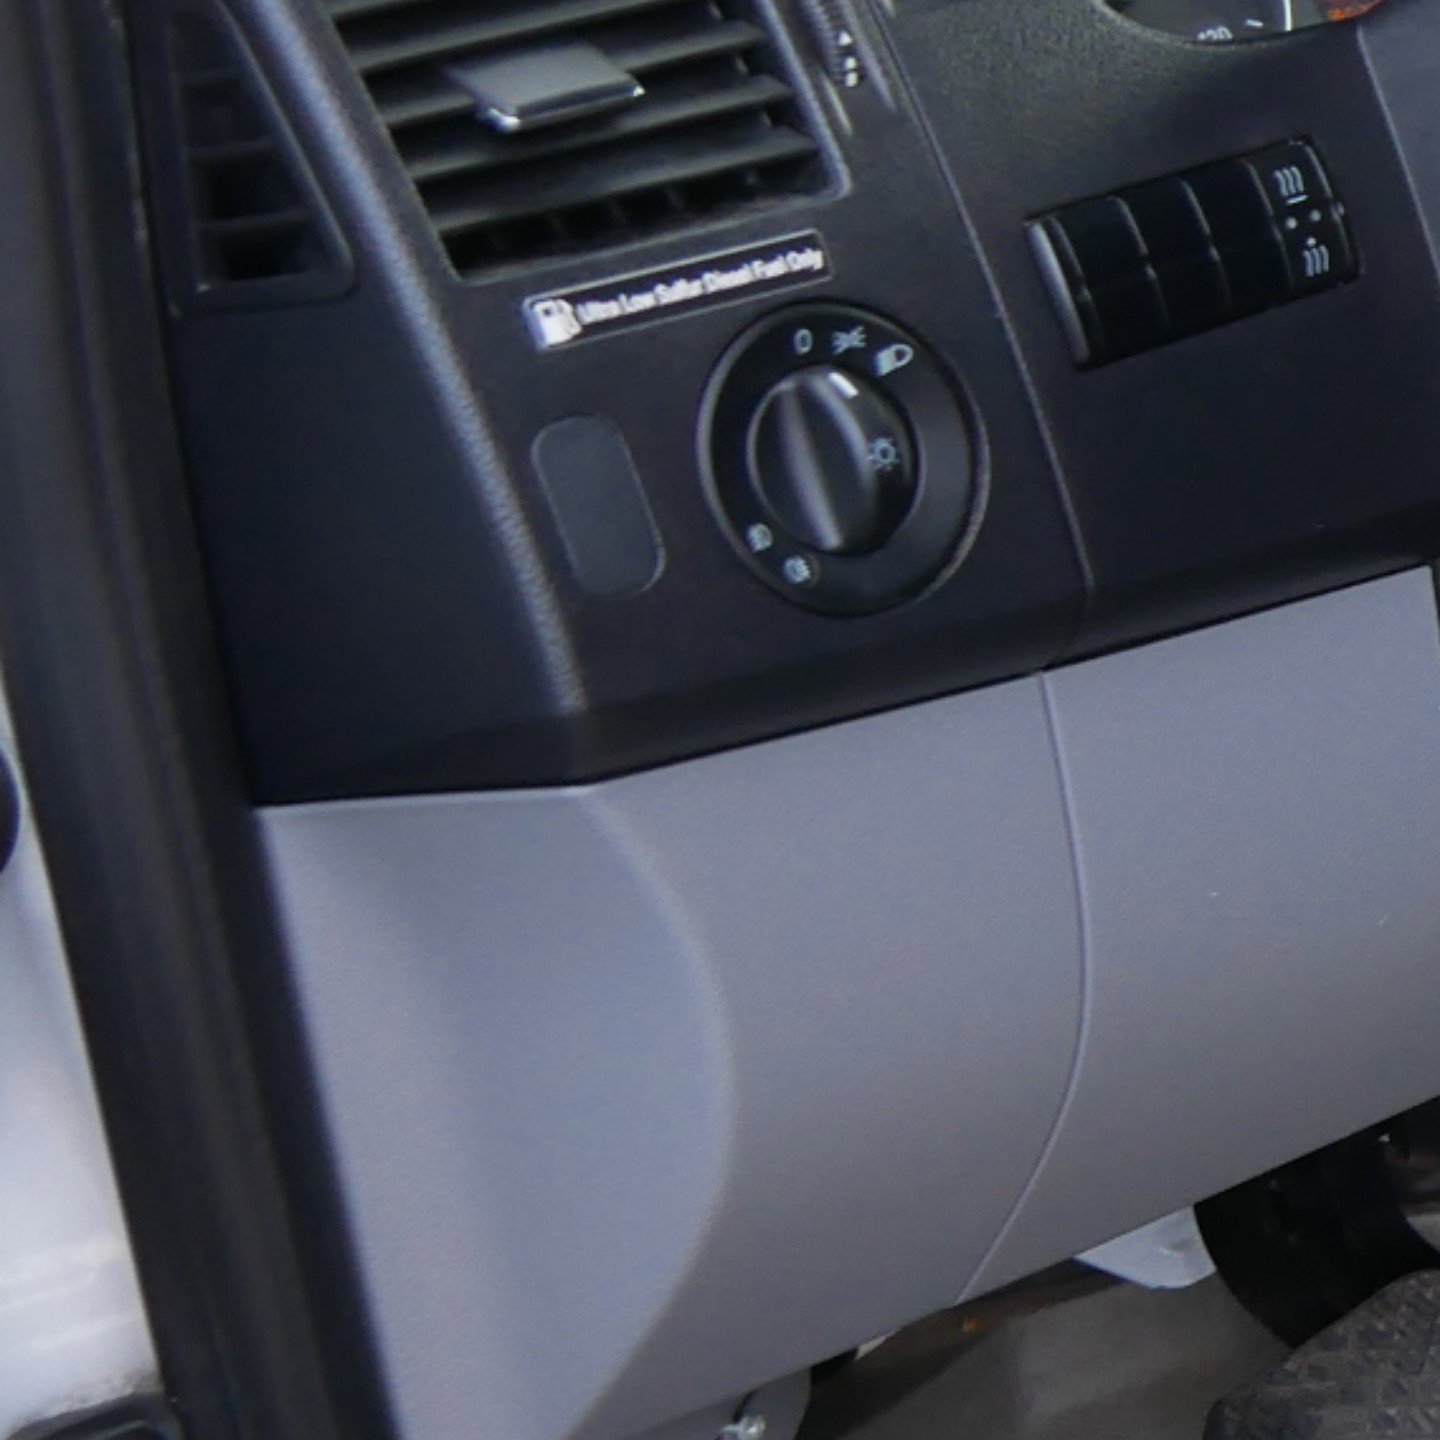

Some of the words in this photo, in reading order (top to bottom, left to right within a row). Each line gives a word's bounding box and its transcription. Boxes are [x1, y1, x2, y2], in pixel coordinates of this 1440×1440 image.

[619, 293, 655, 315] Low
[702, 264, 753, 294] Diesel
[752, 254, 787, 278] Fuel
[786, 248, 823, 271] Only
